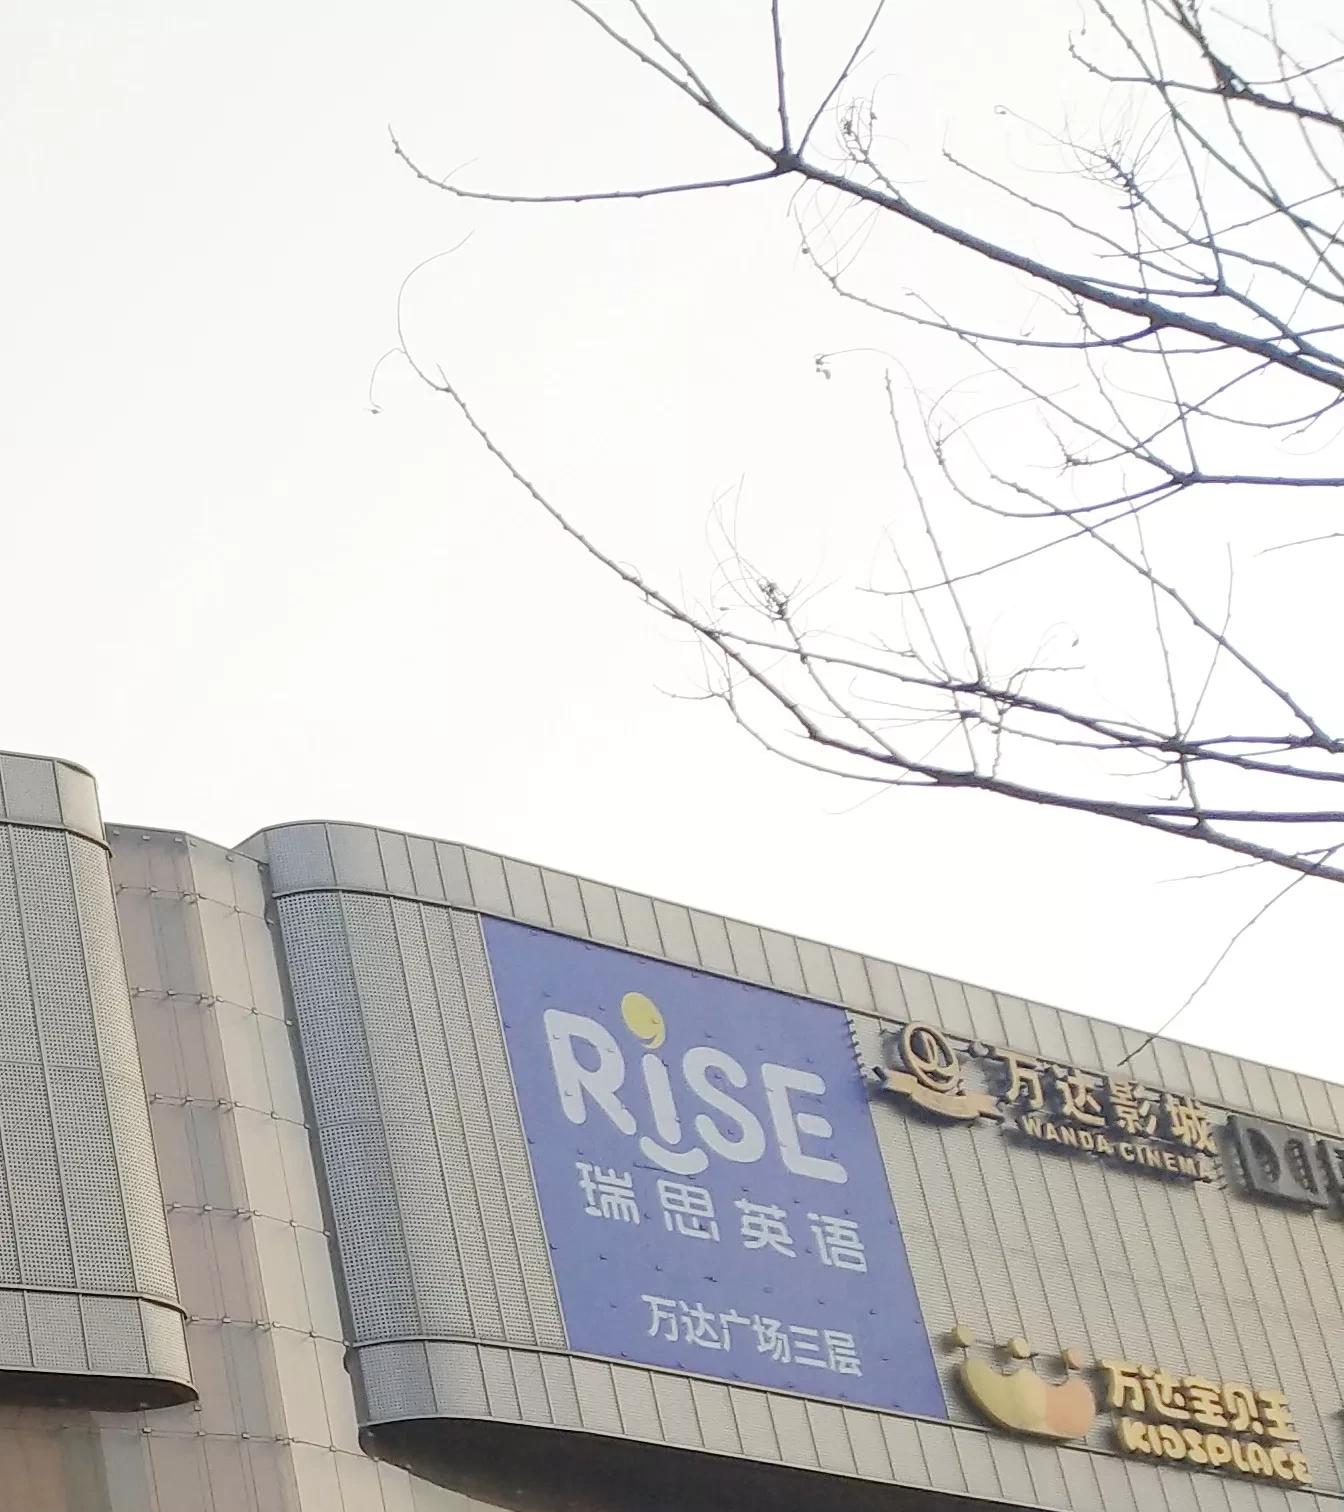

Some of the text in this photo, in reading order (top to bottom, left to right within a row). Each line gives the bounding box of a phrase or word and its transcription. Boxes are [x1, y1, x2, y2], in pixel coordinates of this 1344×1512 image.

[996, 1049, 1217, 1156] 万达影城
[1022, 1114, 1114, 1156] WANDA
[1119, 1141, 1220, 1183] CINEMA
[574, 1161, 870, 1275] 瑞思英语
[640, 1293, 864, 1378] 万达广场三层
[1100, 1357, 1302, 1443] 万达宝贝王
